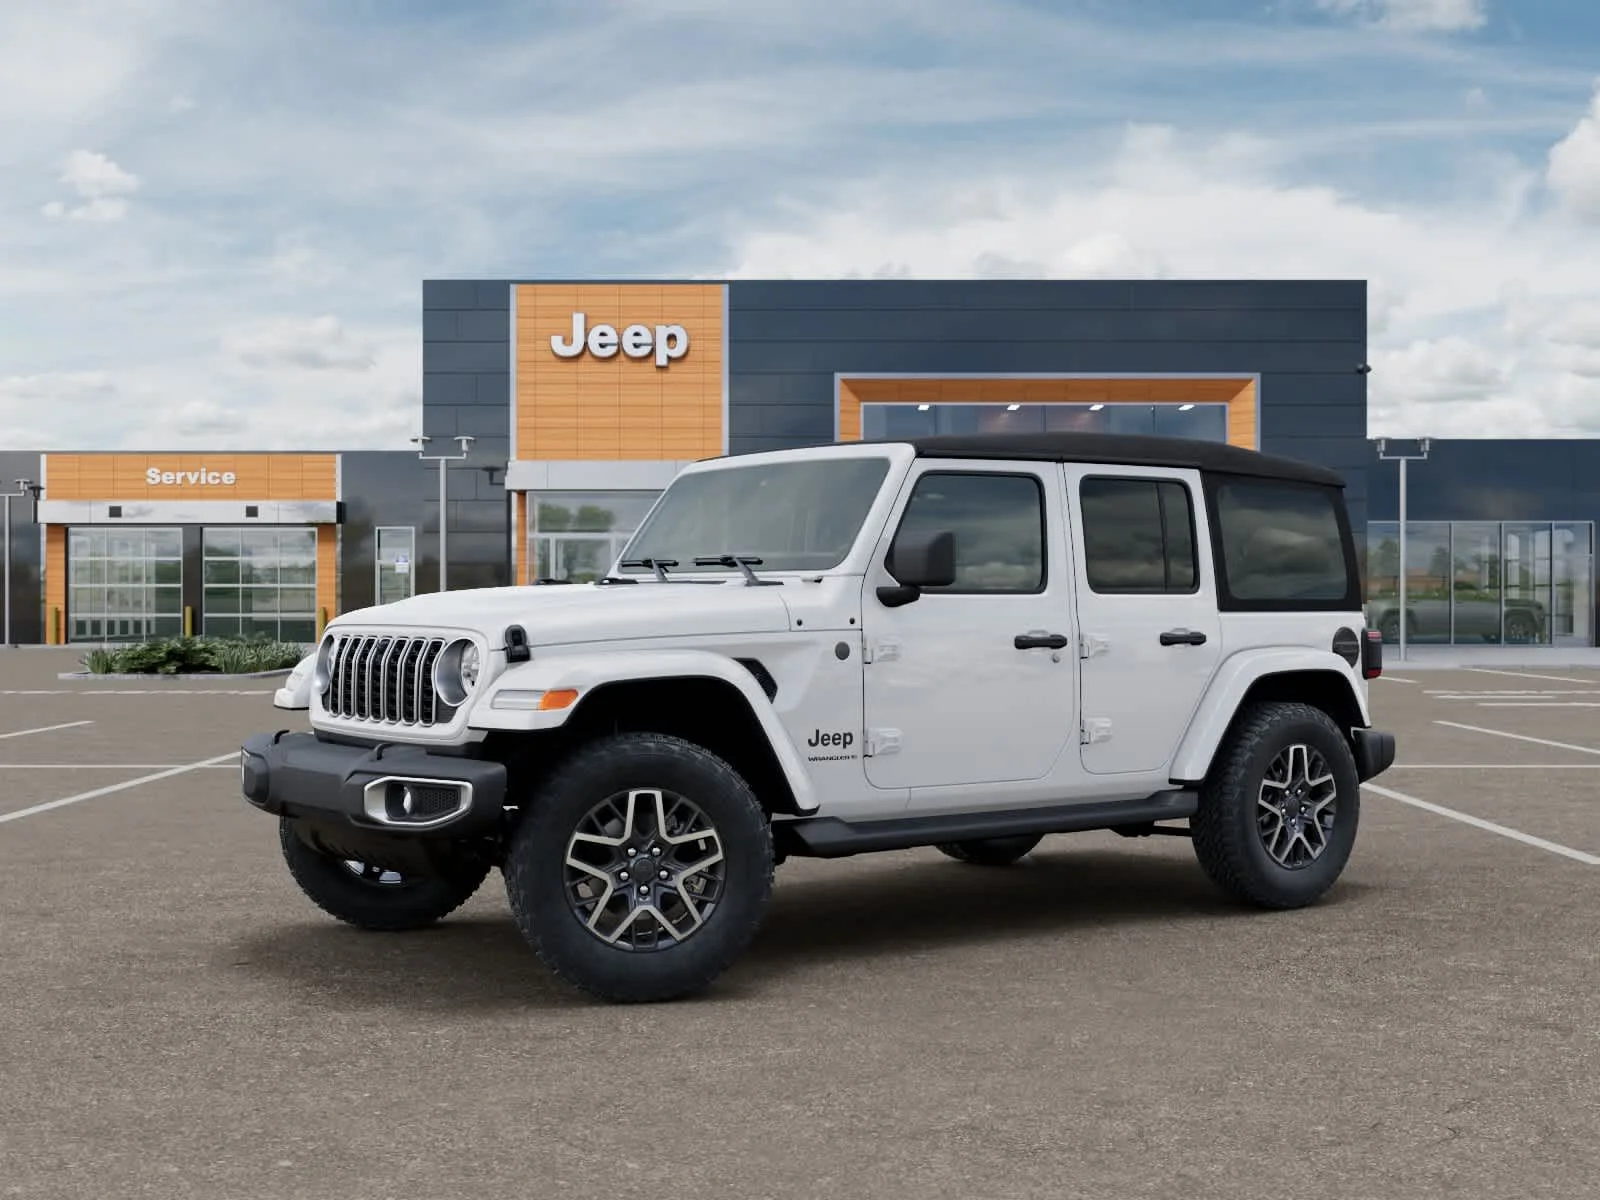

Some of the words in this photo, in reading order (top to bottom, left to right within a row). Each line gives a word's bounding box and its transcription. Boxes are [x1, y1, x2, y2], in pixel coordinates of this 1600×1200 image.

[550, 312, 689, 367] Jeep
[145, 467, 236, 485] Service
[807, 729, 853, 749] Jeep
